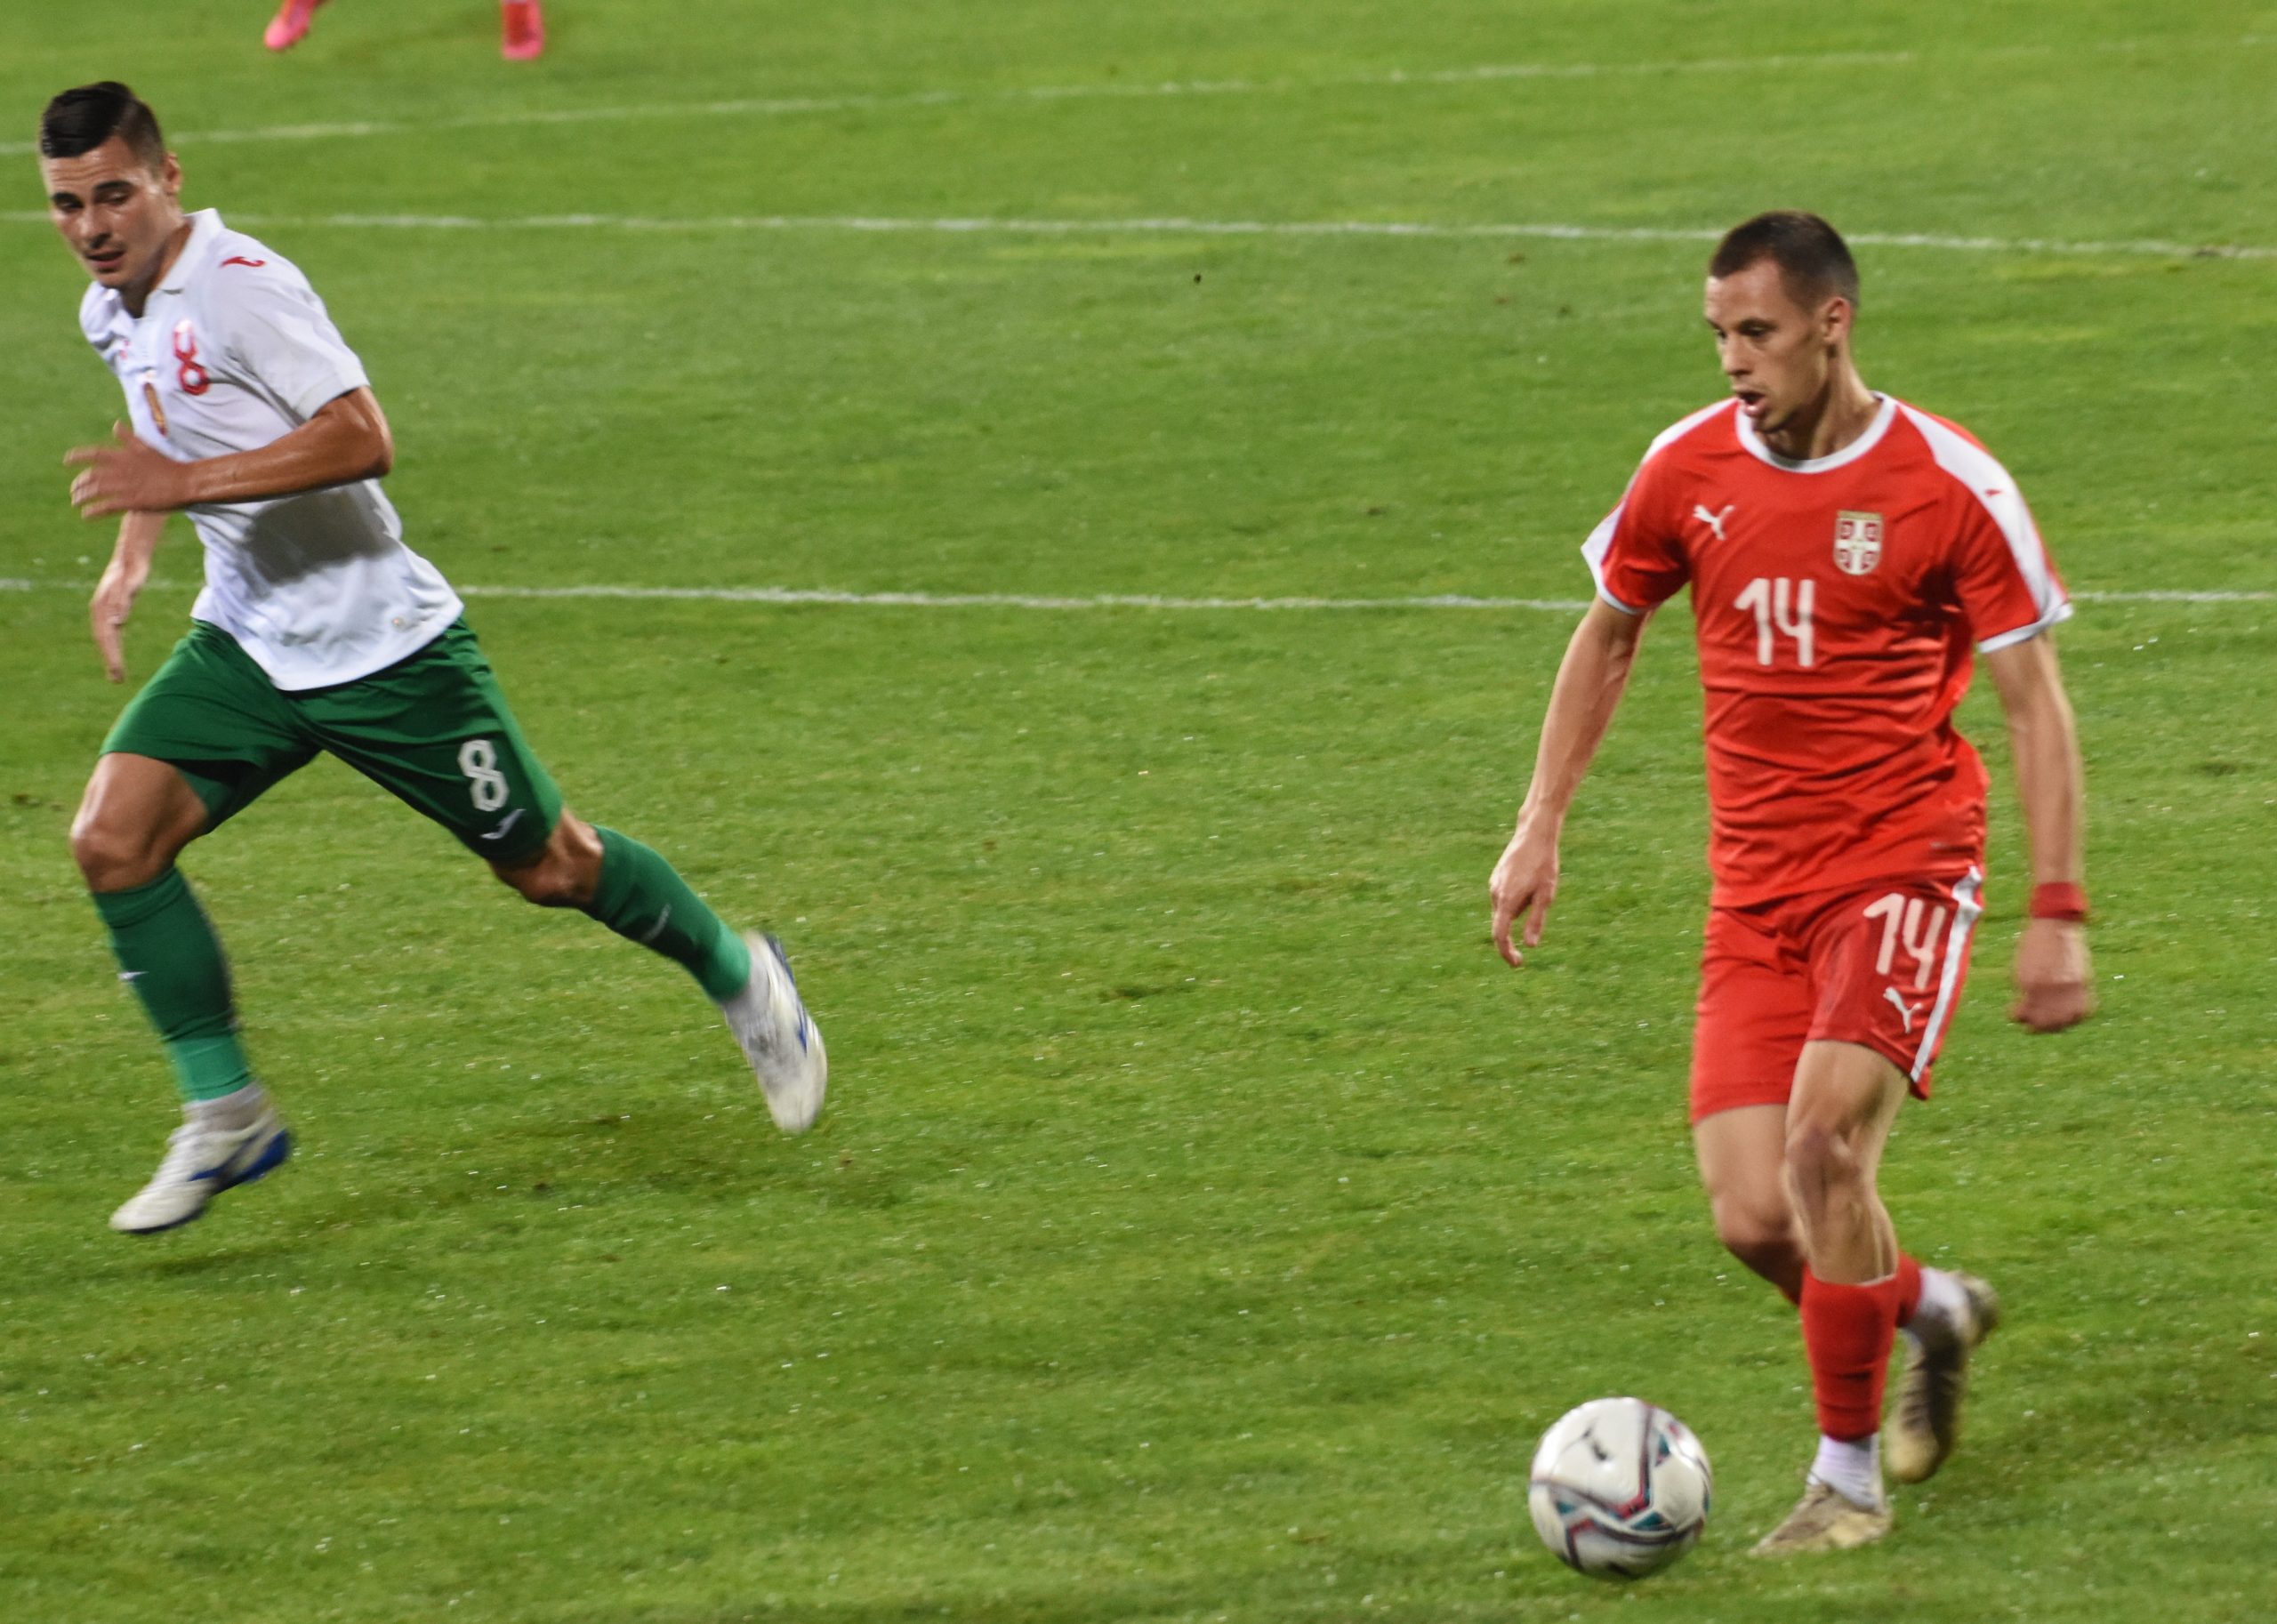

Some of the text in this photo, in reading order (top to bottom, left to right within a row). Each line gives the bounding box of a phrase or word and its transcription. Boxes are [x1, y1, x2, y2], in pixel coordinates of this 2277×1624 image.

[173, 319, 210, 396] 8
[1734, 577, 1814, 667] 14
[457, 739, 510, 812] 8
[1863, 892, 1946, 991] 14
